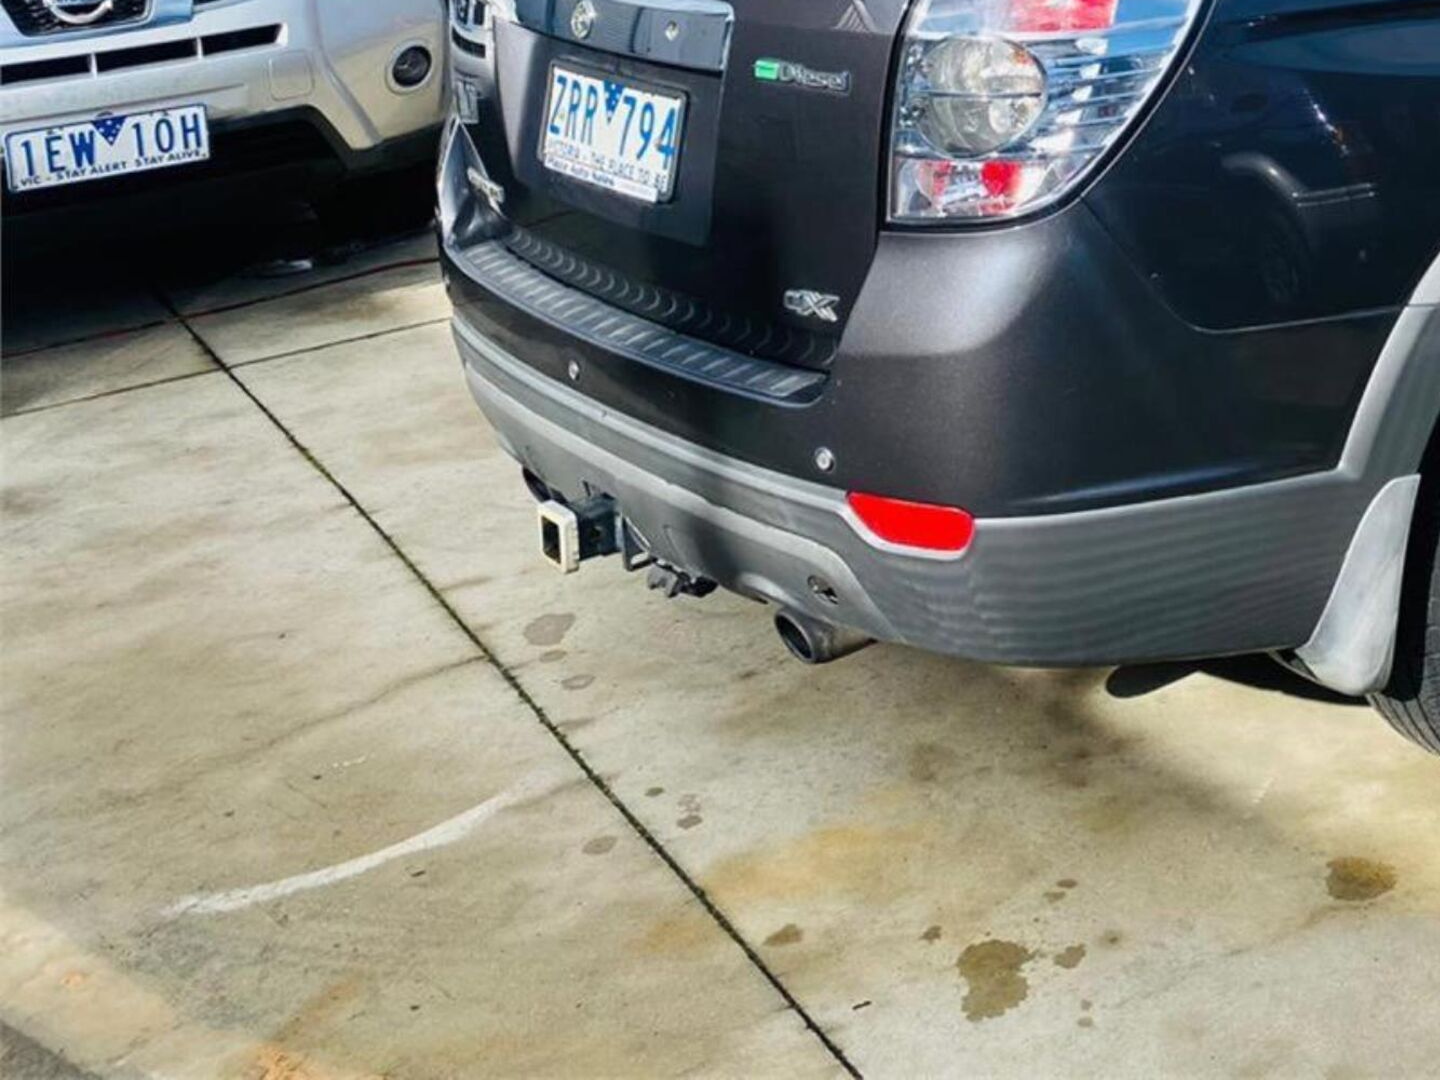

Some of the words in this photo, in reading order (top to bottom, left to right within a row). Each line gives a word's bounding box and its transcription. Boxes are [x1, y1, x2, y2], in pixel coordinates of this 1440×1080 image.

[549, 74, 598, 146] ZRR
[619, 95, 676, 170] 794
[20, 130, 95, 177] 1EW
[56, 167, 86, 182] STAY
[91, 161, 128, 176] ALERT
[135, 156, 164, 168] STAY
[167, 149, 202, 162] ALIVE
